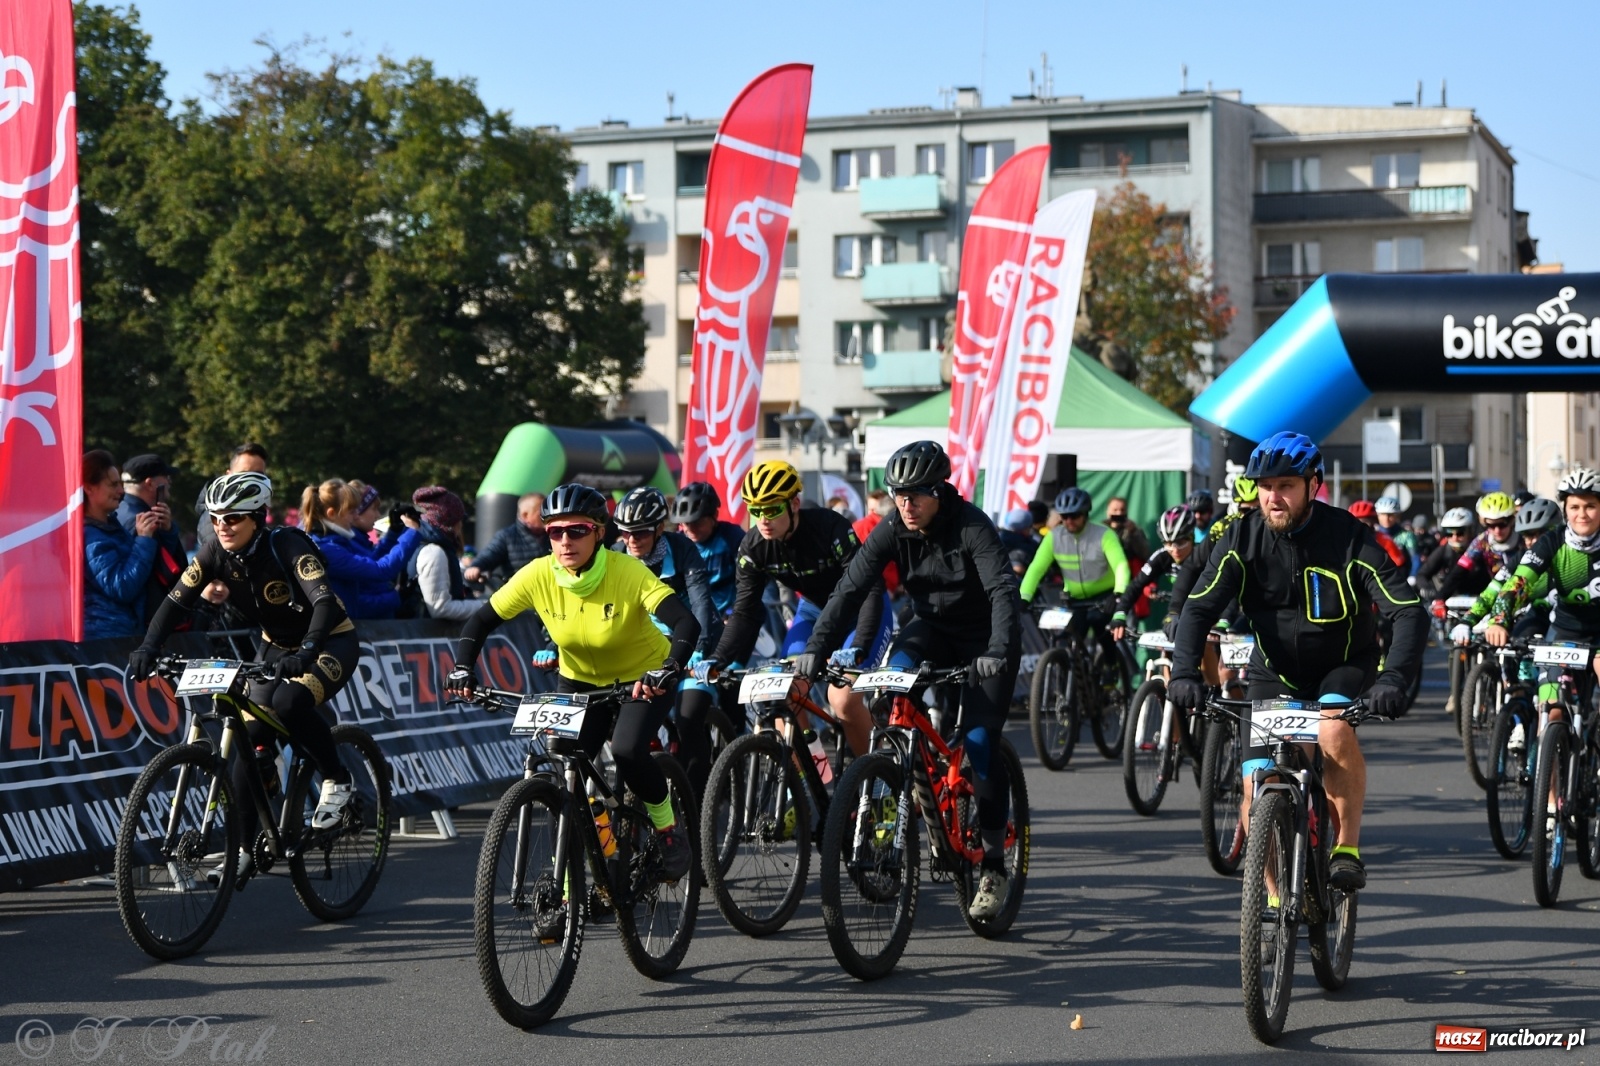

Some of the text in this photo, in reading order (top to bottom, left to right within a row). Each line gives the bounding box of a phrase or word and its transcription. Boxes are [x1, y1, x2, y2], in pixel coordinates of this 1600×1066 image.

[1443, 313, 1543, 360] bike
[1545, 650, 1581, 662] 1570
[187, 672, 226, 686] 2113
[865, 674, 905, 684] 1656
[527, 709, 574, 727] 1535
[1262, 715, 1308, 731] 2822
[571, 902, 585, 962] MAXXIS
